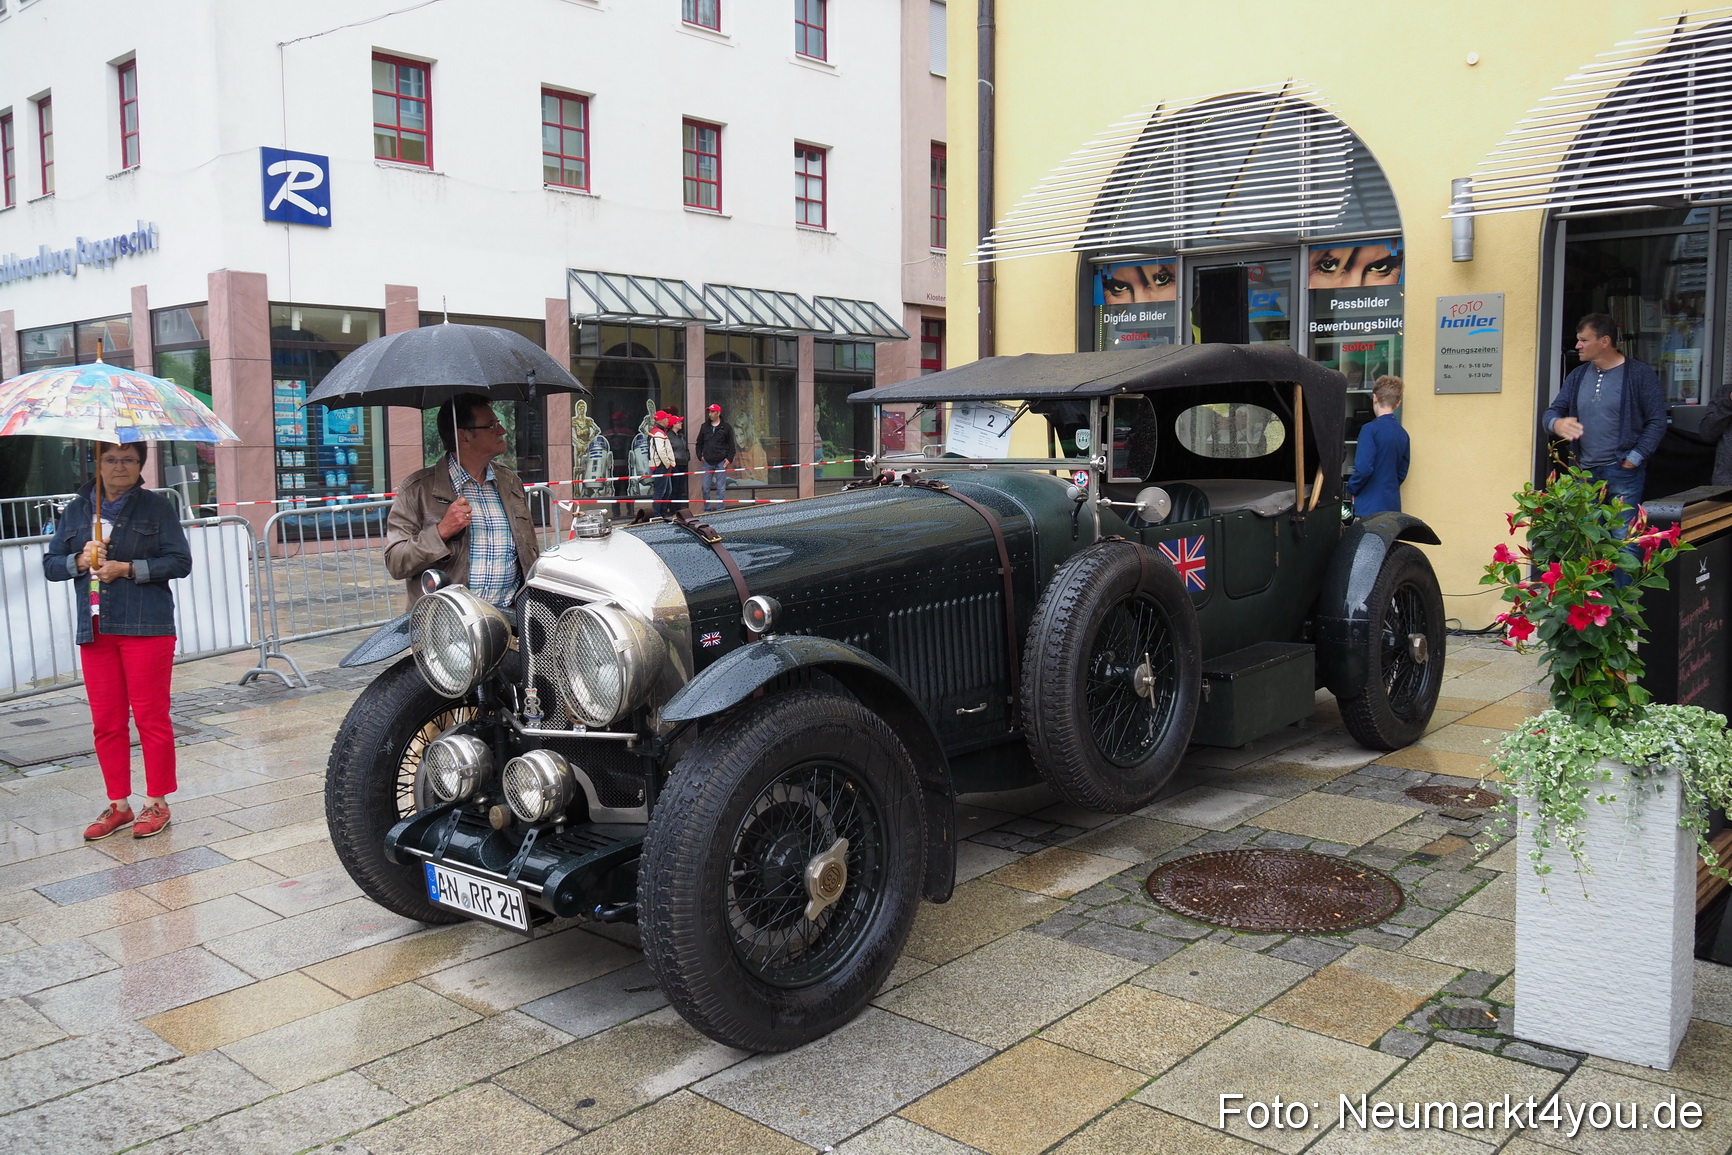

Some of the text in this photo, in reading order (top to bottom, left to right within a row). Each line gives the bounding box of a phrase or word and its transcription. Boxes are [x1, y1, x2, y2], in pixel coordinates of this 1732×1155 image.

[76, 219, 158, 269] Rupprecht
[1330, 297, 1390, 310] Passbilder
[1449, 300, 1483, 318] FOTO
[1103, 311, 1167, 325] Digitale Bilder
[1440, 315, 1497, 328] hailer
[1121, 331, 1149, 342] sofort
[1342, 341, 1376, 352] sofort
[1440, 346, 1499, 355] Öffnungszeiten:
[986, 414, 995, 428] 2
[438, 871, 524, 925] AN RR 2H
